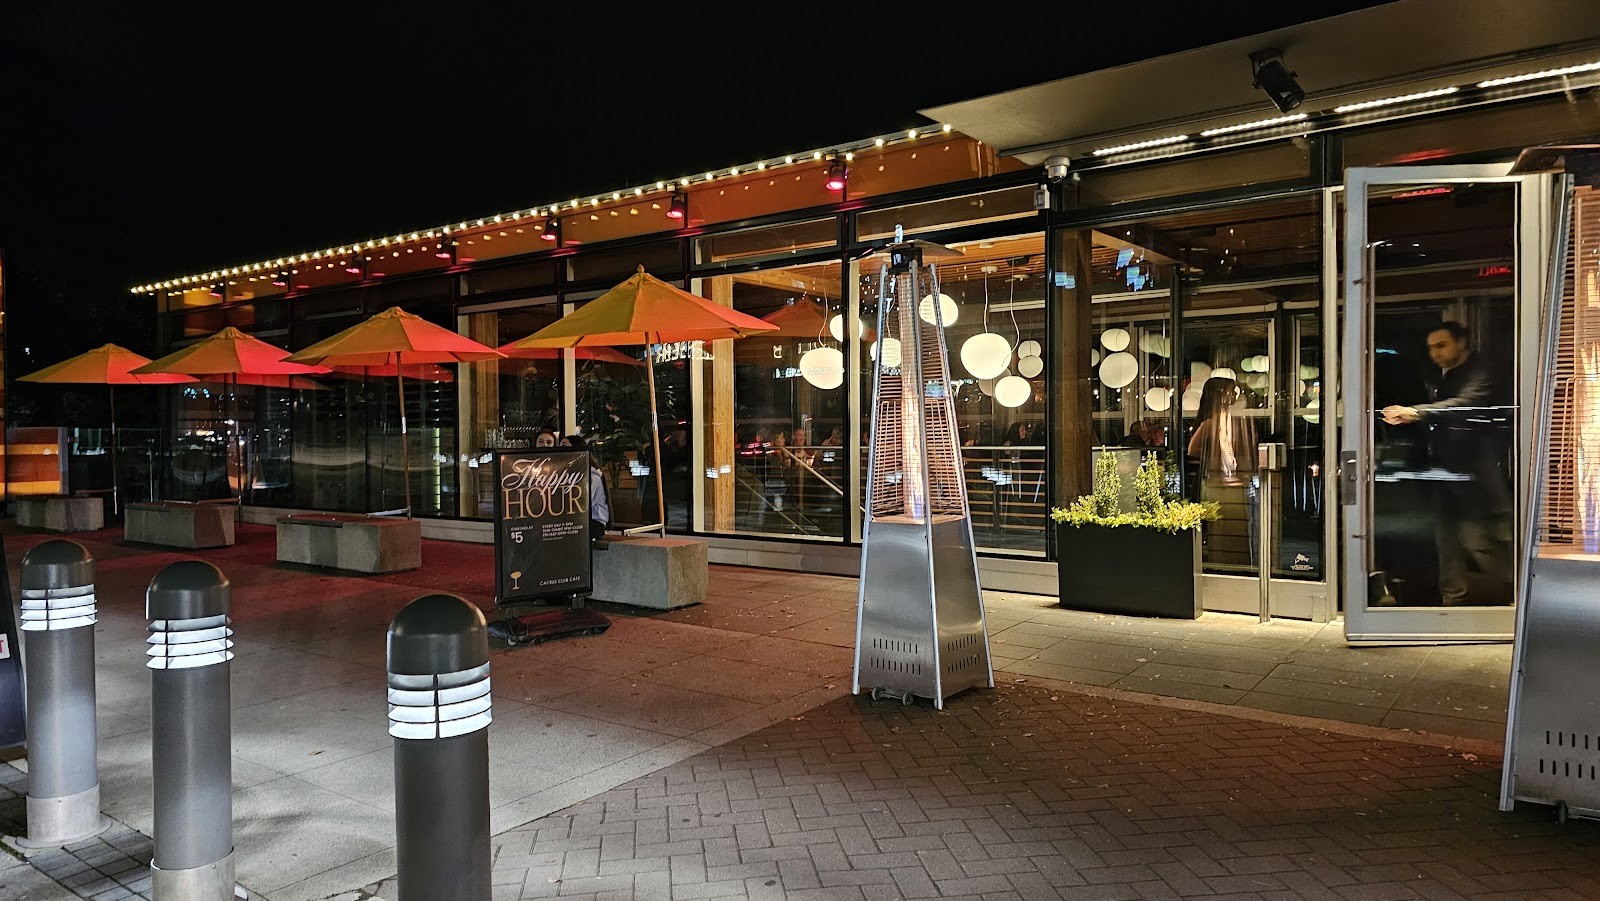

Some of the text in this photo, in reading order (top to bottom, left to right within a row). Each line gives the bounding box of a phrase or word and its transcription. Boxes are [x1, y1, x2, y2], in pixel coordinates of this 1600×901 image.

[501, 458, 583, 495] Happy
[502, 485, 585, 520] HOUR
[511, 531, 524, 544] $5
